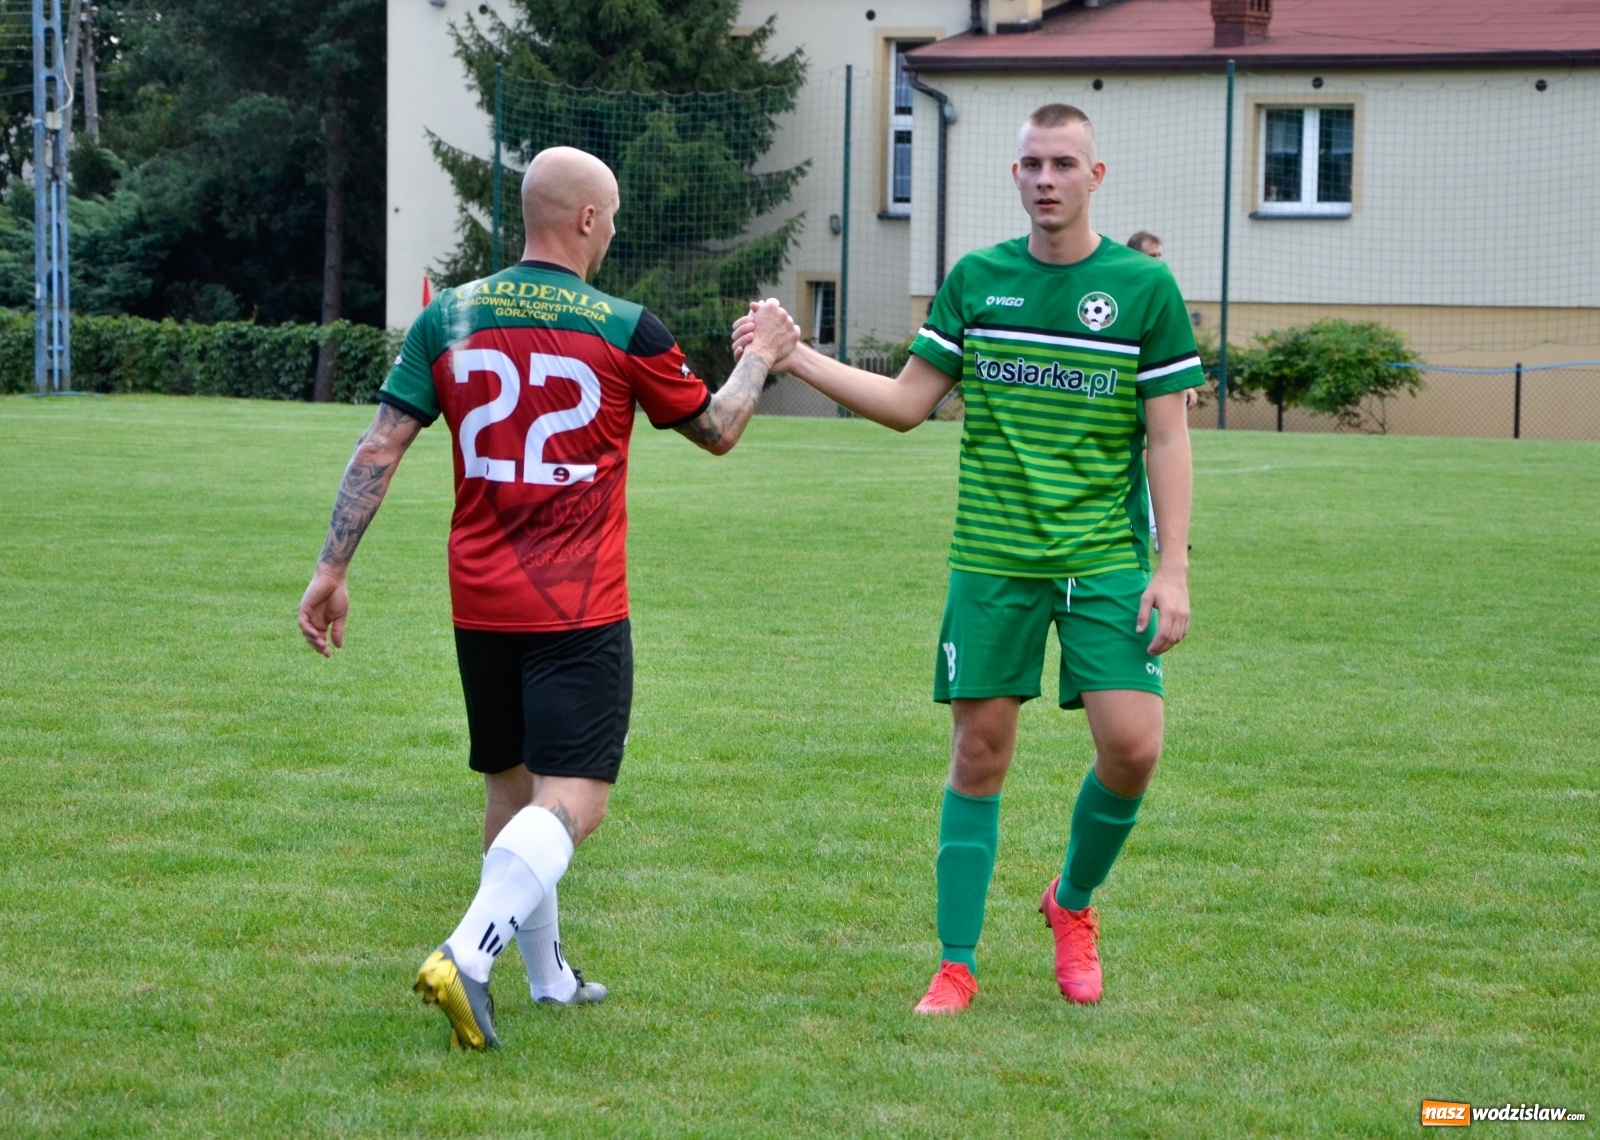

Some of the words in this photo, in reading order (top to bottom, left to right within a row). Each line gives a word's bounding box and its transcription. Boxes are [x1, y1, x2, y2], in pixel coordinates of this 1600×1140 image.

[456, 296, 517, 309] PRACOWNIA
[519, 300, 607, 324] FLORYSTYCZNA
[495, 308, 559, 322] GORZYCZKI
[974, 352, 1118, 400] kosiarka.pl
[452, 348, 602, 486] 22
